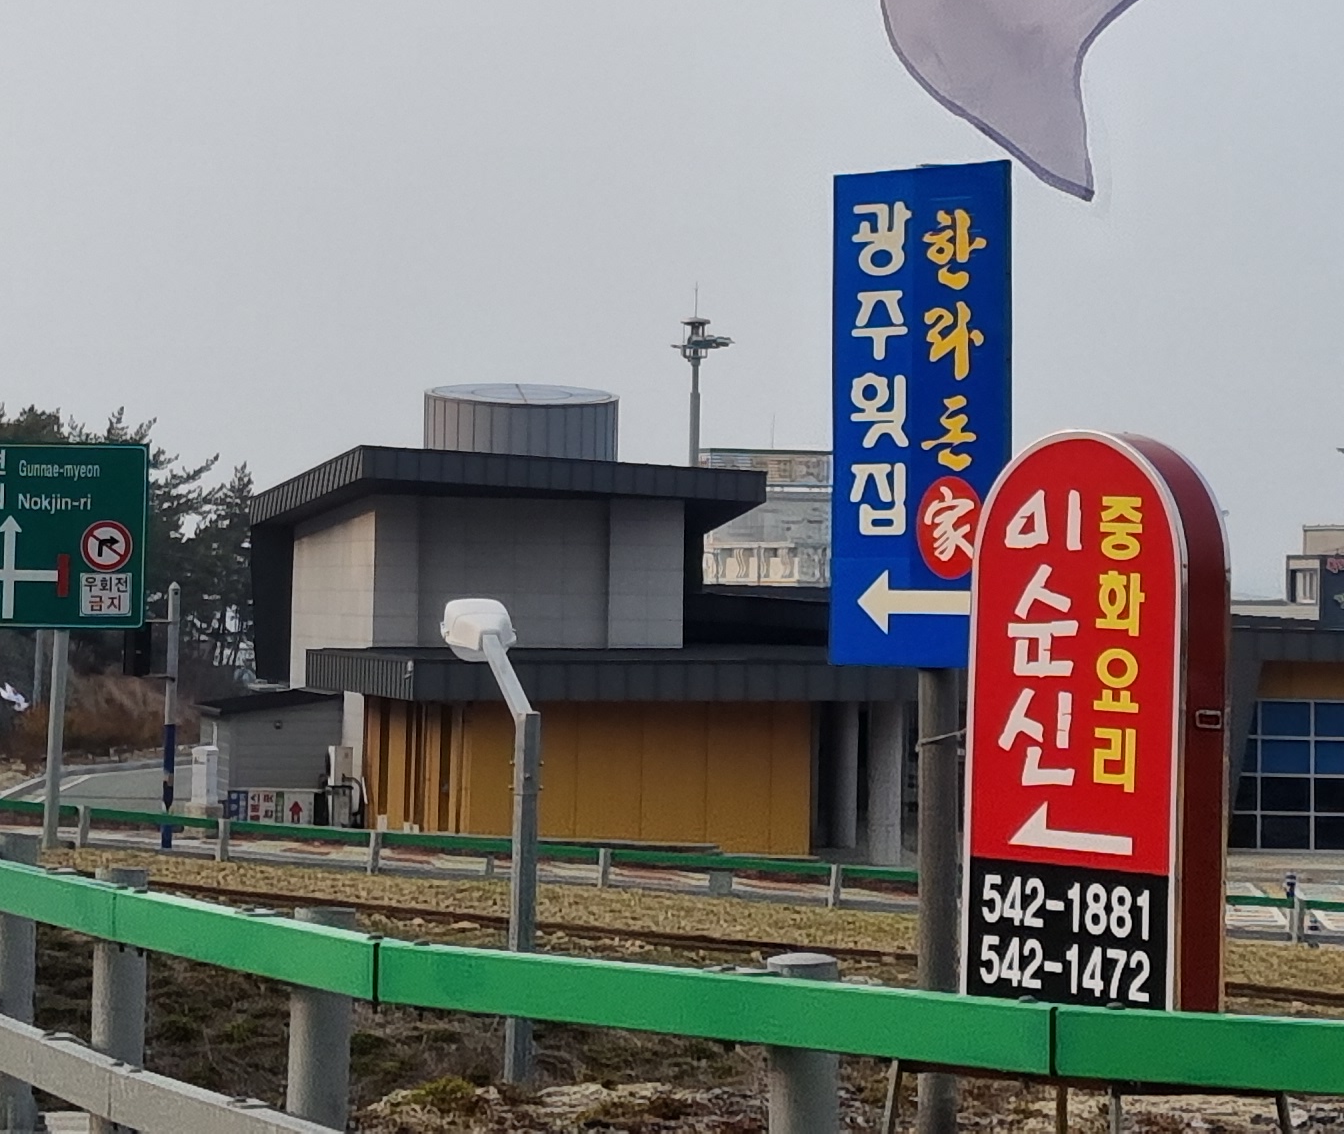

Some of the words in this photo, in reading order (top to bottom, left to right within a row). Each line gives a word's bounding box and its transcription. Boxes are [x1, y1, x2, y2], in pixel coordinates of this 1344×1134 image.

[850, 201, 912, 536] 광주횟집
[17, 493, 92, 514] Nokjin-ri
[18, 460, 101, 481] Gunnae-myeon
[84, 576, 129, 592] 우회전
[89, 595, 122, 612] 금지
[998, 489, 1082, 786] 이순신
[1093, 496, 1145, 793] 중화요리
[981, 874, 1150, 941] 542-1881
[979, 934, 1150, 1003] 542-1472
